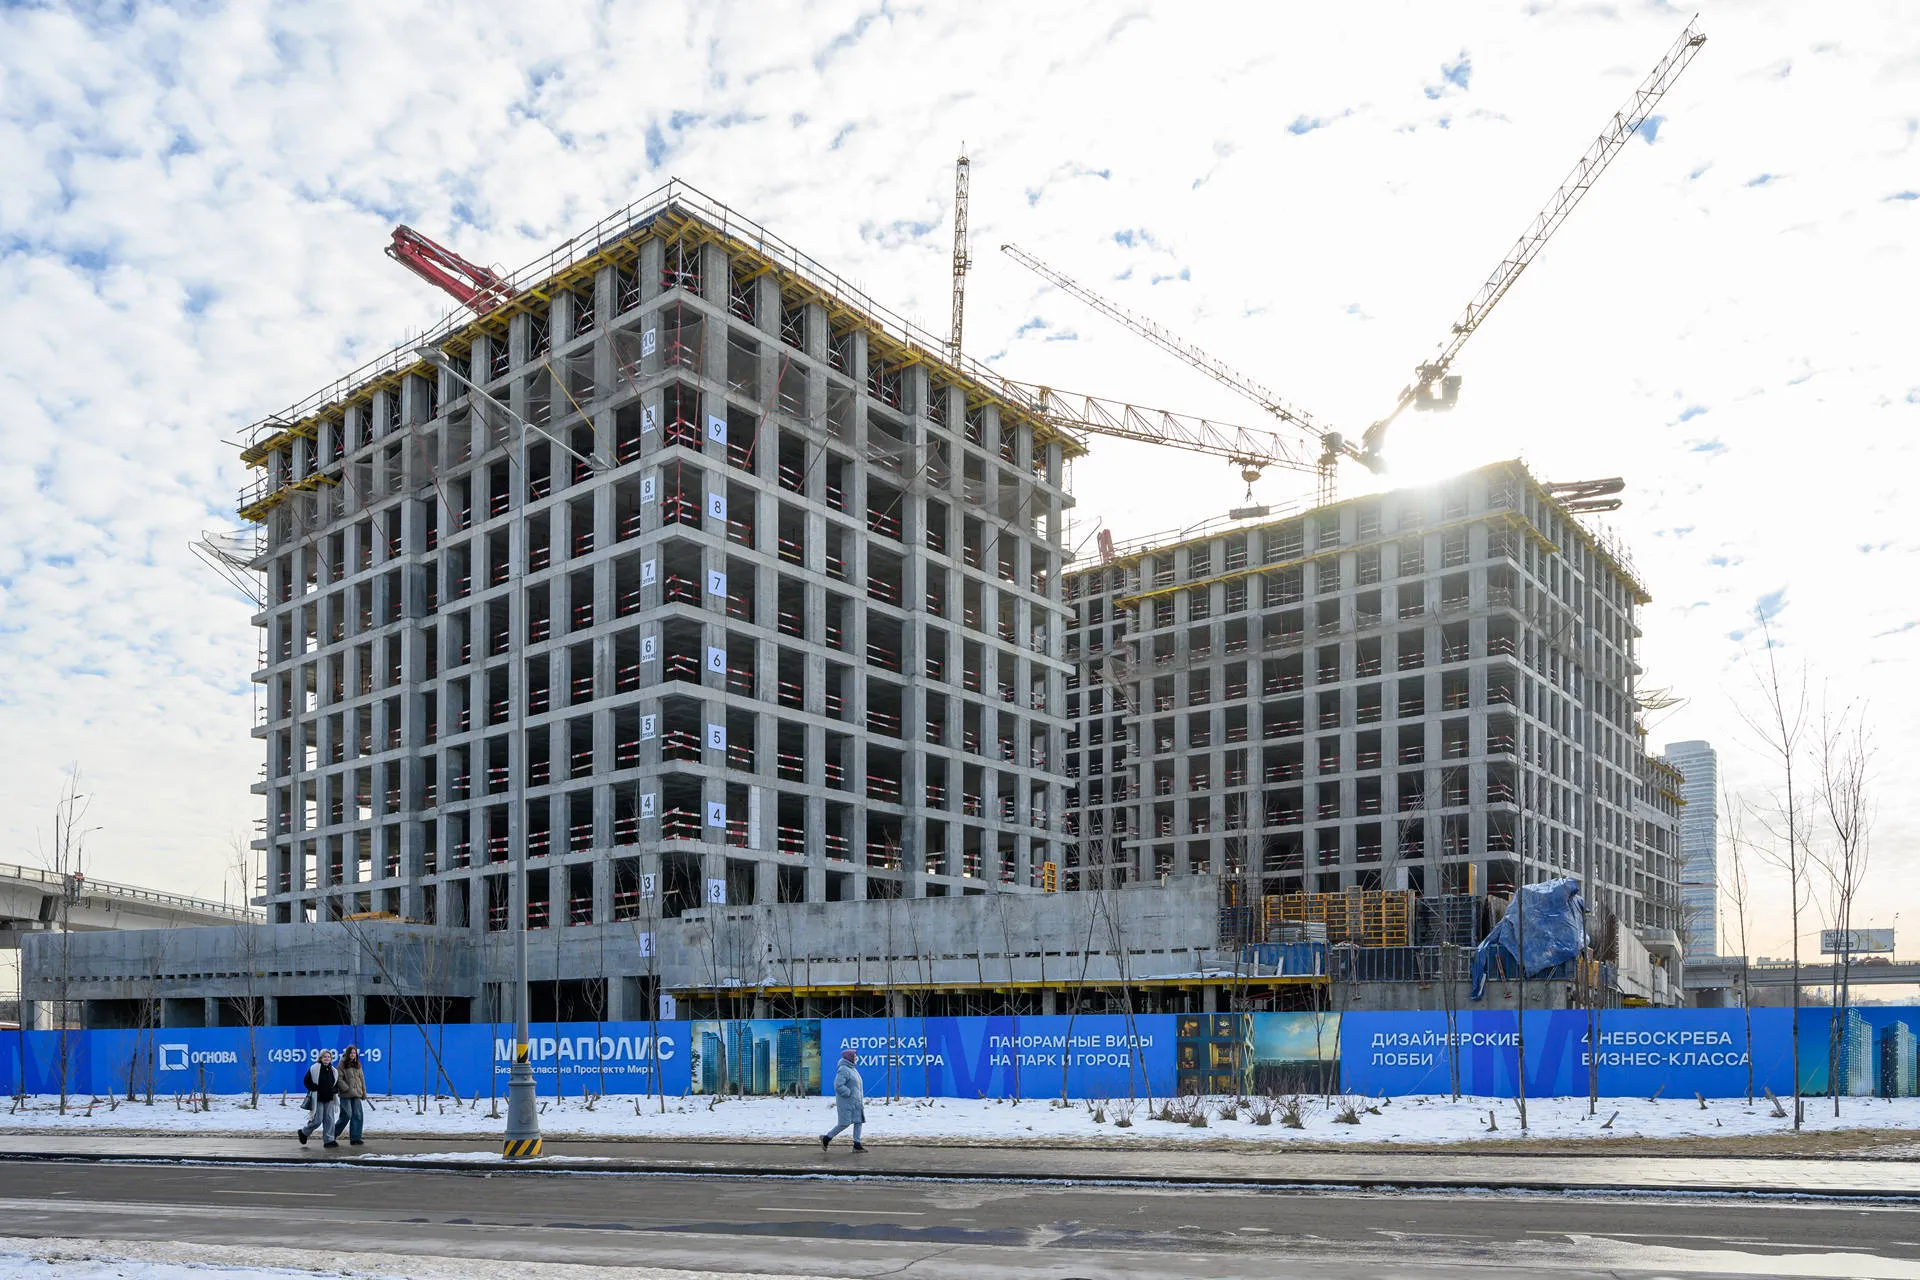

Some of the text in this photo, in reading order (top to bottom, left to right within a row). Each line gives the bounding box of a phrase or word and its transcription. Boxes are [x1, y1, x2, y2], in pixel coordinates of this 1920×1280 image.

[643, 332, 655, 346] 10
[646, 410, 652, 423] 9
[714, 423, 721, 437] 9
[645, 481, 651, 494] 8
[714, 501, 721, 514] 8
[645, 564, 652, 577] 7
[714, 576, 721, 590] 7
[645, 640, 651, 653] 6
[713, 654, 721, 667] 6
[645, 718, 651, 731] 5
[713, 731, 721, 744] 5
[644, 796, 651, 809] 4
[713, 809, 721, 822] 4
[645, 876, 651, 889] 3
[713, 884, 721, 898] 3
[644, 938, 651, 952] 2
[665, 1001, 670, 1014] 1
[840, 1036, 927, 1049] АВТОРСКАЯ
[989, 1035, 1153, 1049] ПАНОРАМНЫЕ ВИДЫ
[1371, 1030, 1521, 1048] ДИЗАЙНЕРСКИЕ
[1599, 1031, 1733, 1045] НЕБОСКРЕБА
[191, 1051, 238, 1064] ОСНОВА
[267, 1048, 307, 1063] (495)
[855, 1054, 945, 1067] ХИТЕКТУРА
[989, 1054, 1131, 1068] НА ПАРК И ГОРОД
[1371, 1053, 1433, 1066] ЛОББИ
[1581, 1052, 1753, 1066] БИЗНЕС-КЛАССА
[495, 1065, 558, 1074] Бизкласс
